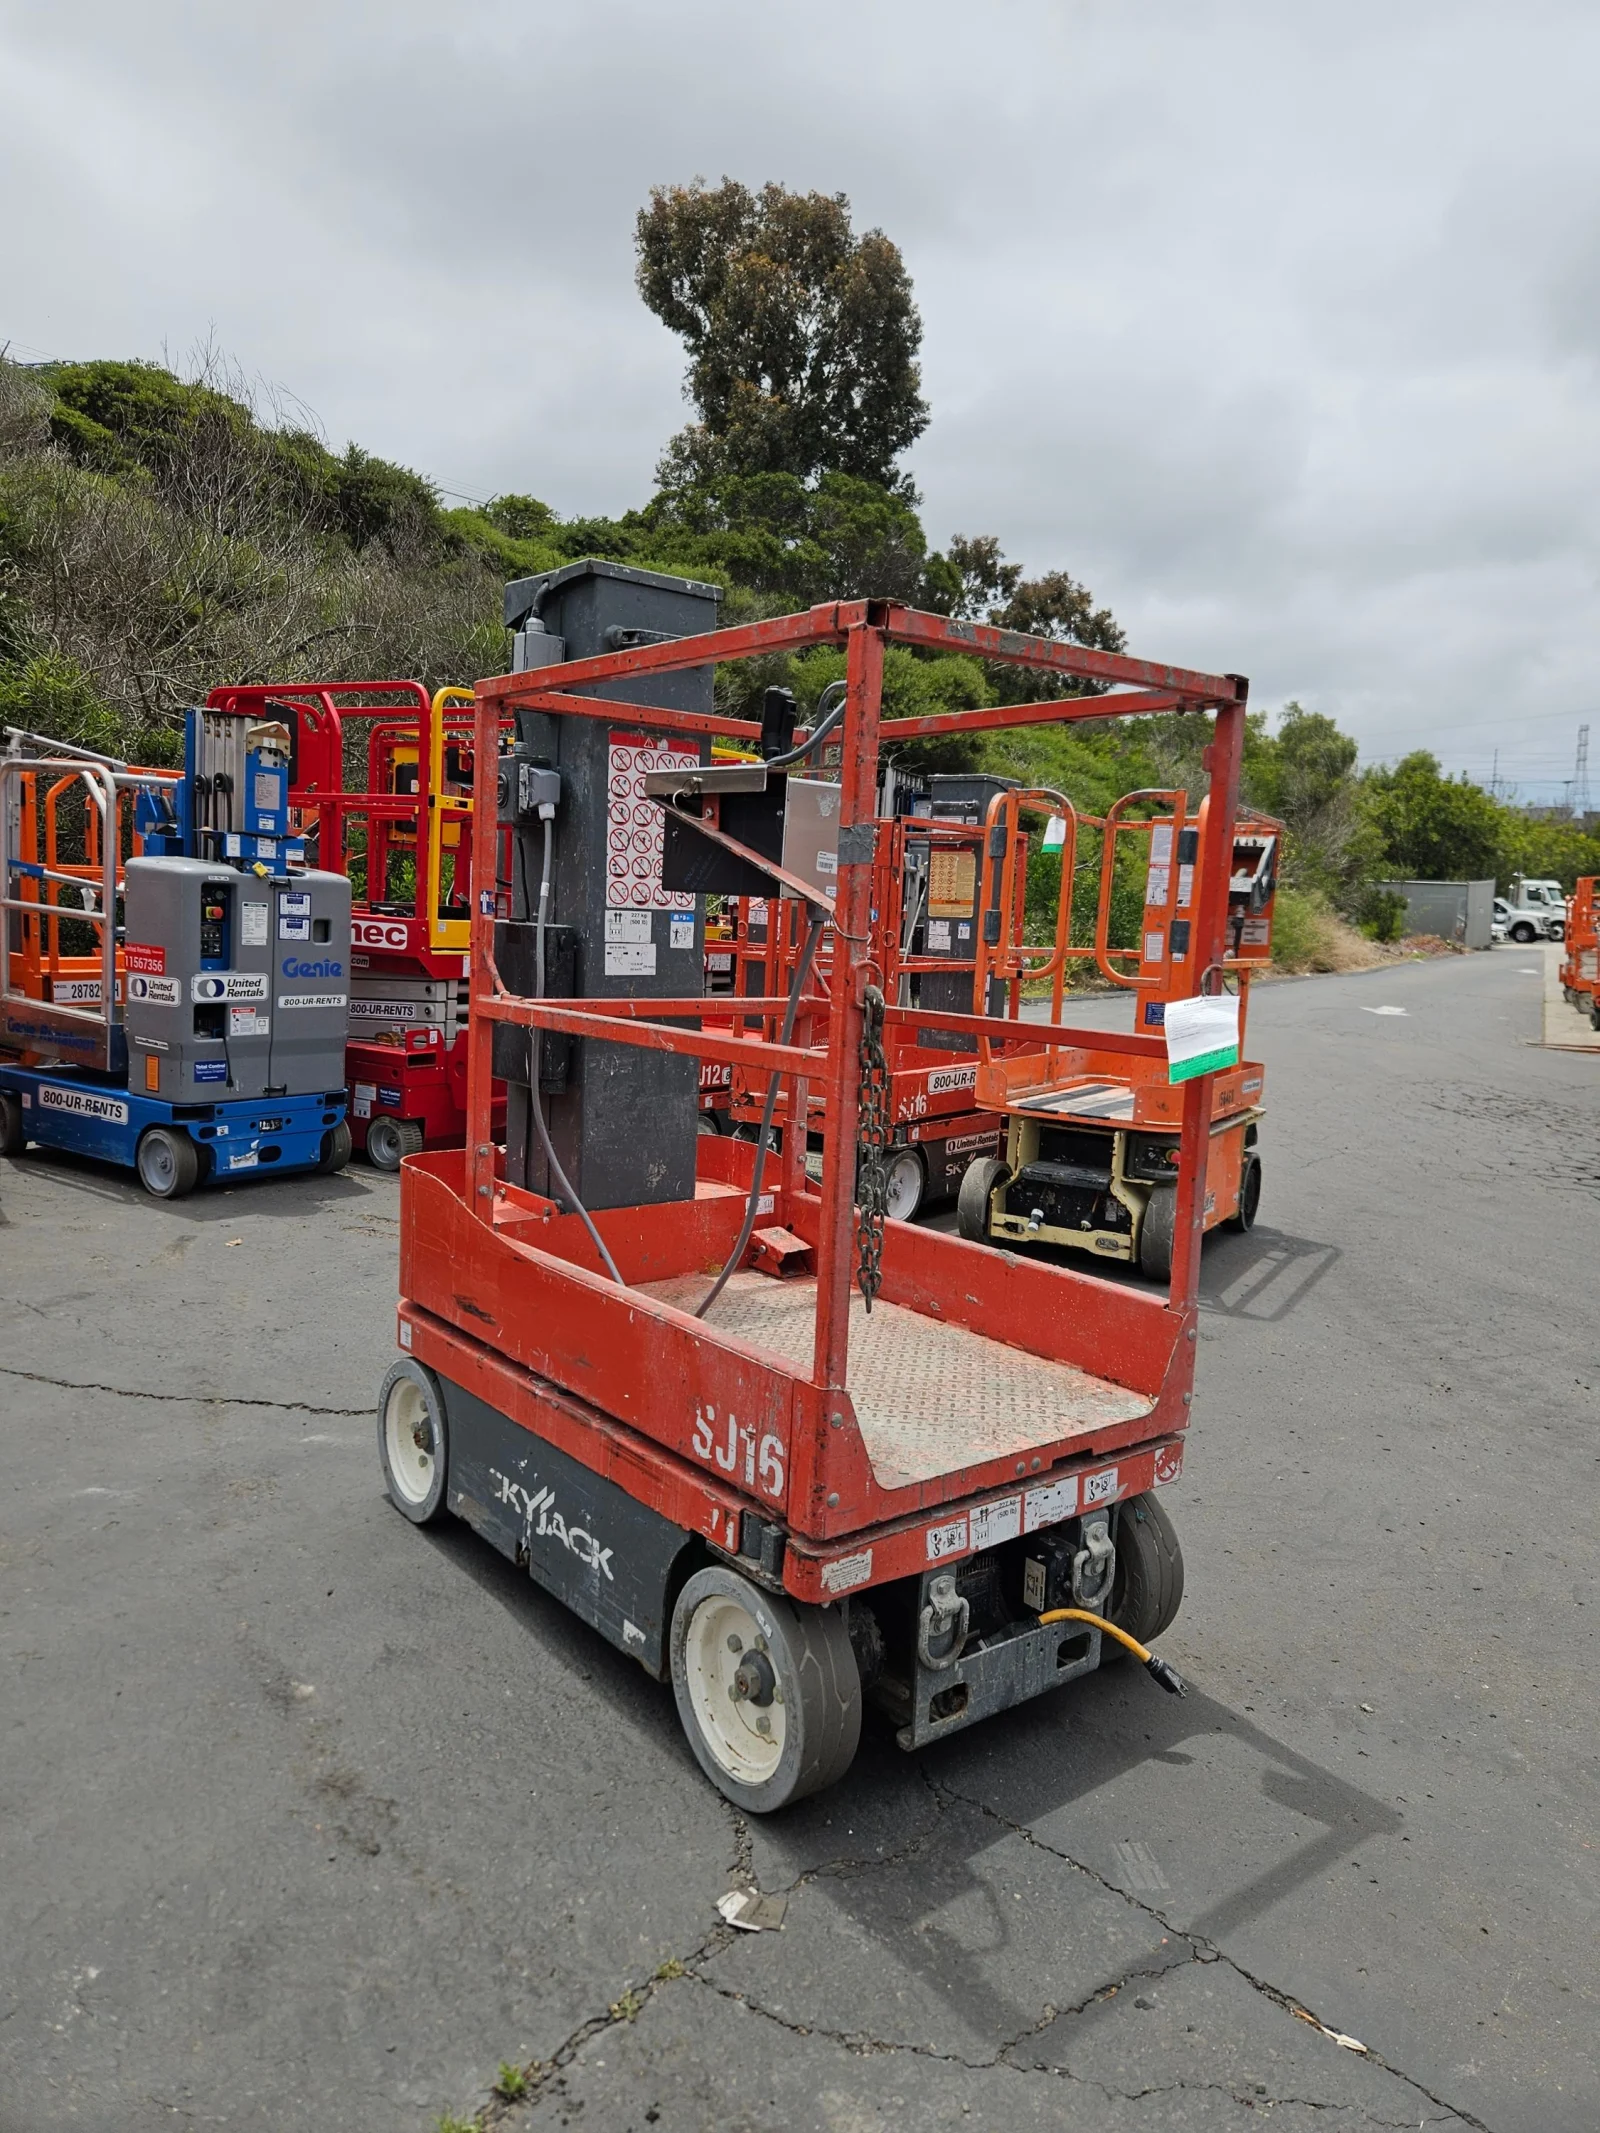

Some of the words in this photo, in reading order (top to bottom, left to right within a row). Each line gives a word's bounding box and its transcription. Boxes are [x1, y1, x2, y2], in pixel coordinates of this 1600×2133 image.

[125, 955, 163, 972] 11567356
[282, 957, 343, 978] Genie
[149, 980, 173, 991] United
[227, 978, 262, 988] United
[148, 990, 176, 1002] Rentals
[227, 988, 264, 997] Rentals
[284, 997, 342, 1006] 800-UR-RENTS
[350, 1003, 414, 1017] 800-UR-RENTS
[43, 1090, 123, 1119] 800-UR-RENTS
[692, 1405, 784, 1498] SJ16
